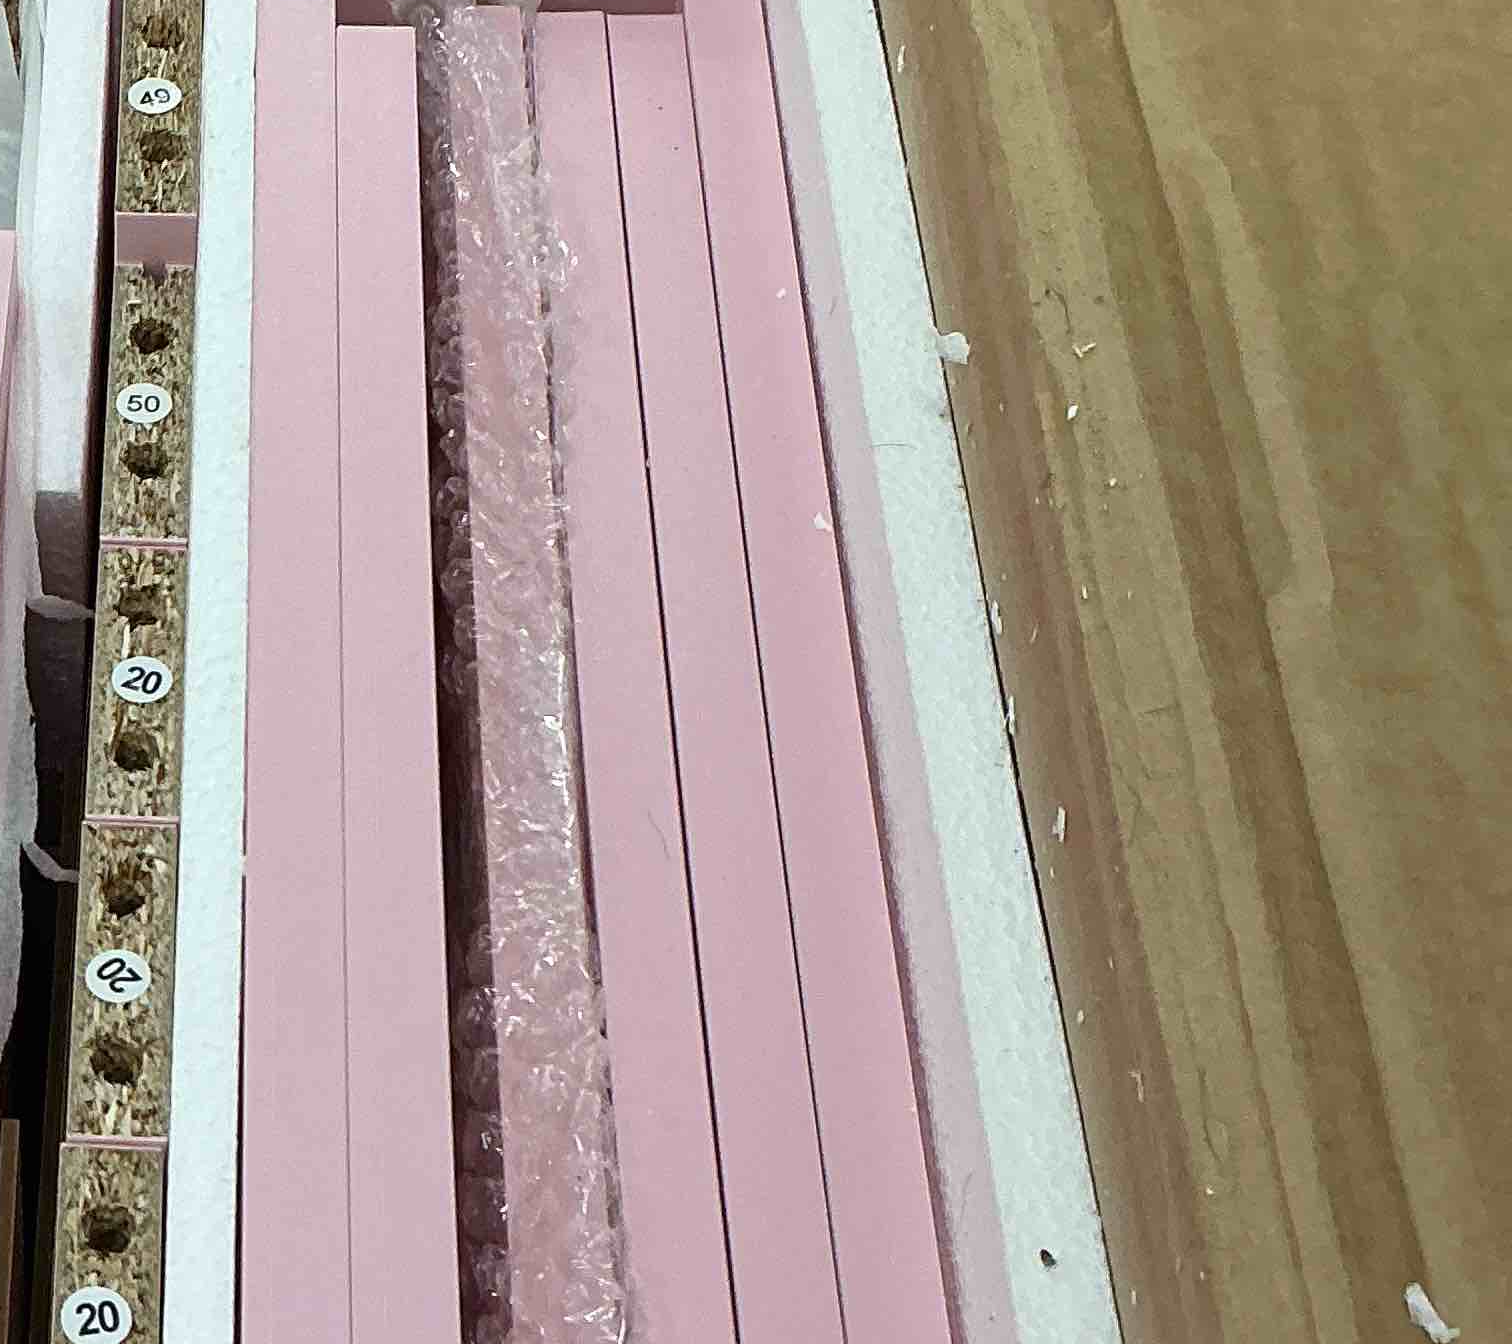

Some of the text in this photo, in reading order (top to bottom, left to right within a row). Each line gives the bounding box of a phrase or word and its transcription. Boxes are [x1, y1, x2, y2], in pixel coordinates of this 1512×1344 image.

[139, 87, 171, 106] 49
[127, 394, 161, 413] 50
[120, 666, 163, 695] 20
[96, 957, 143, 994] 20
[75, 1300, 120, 1337] 20
